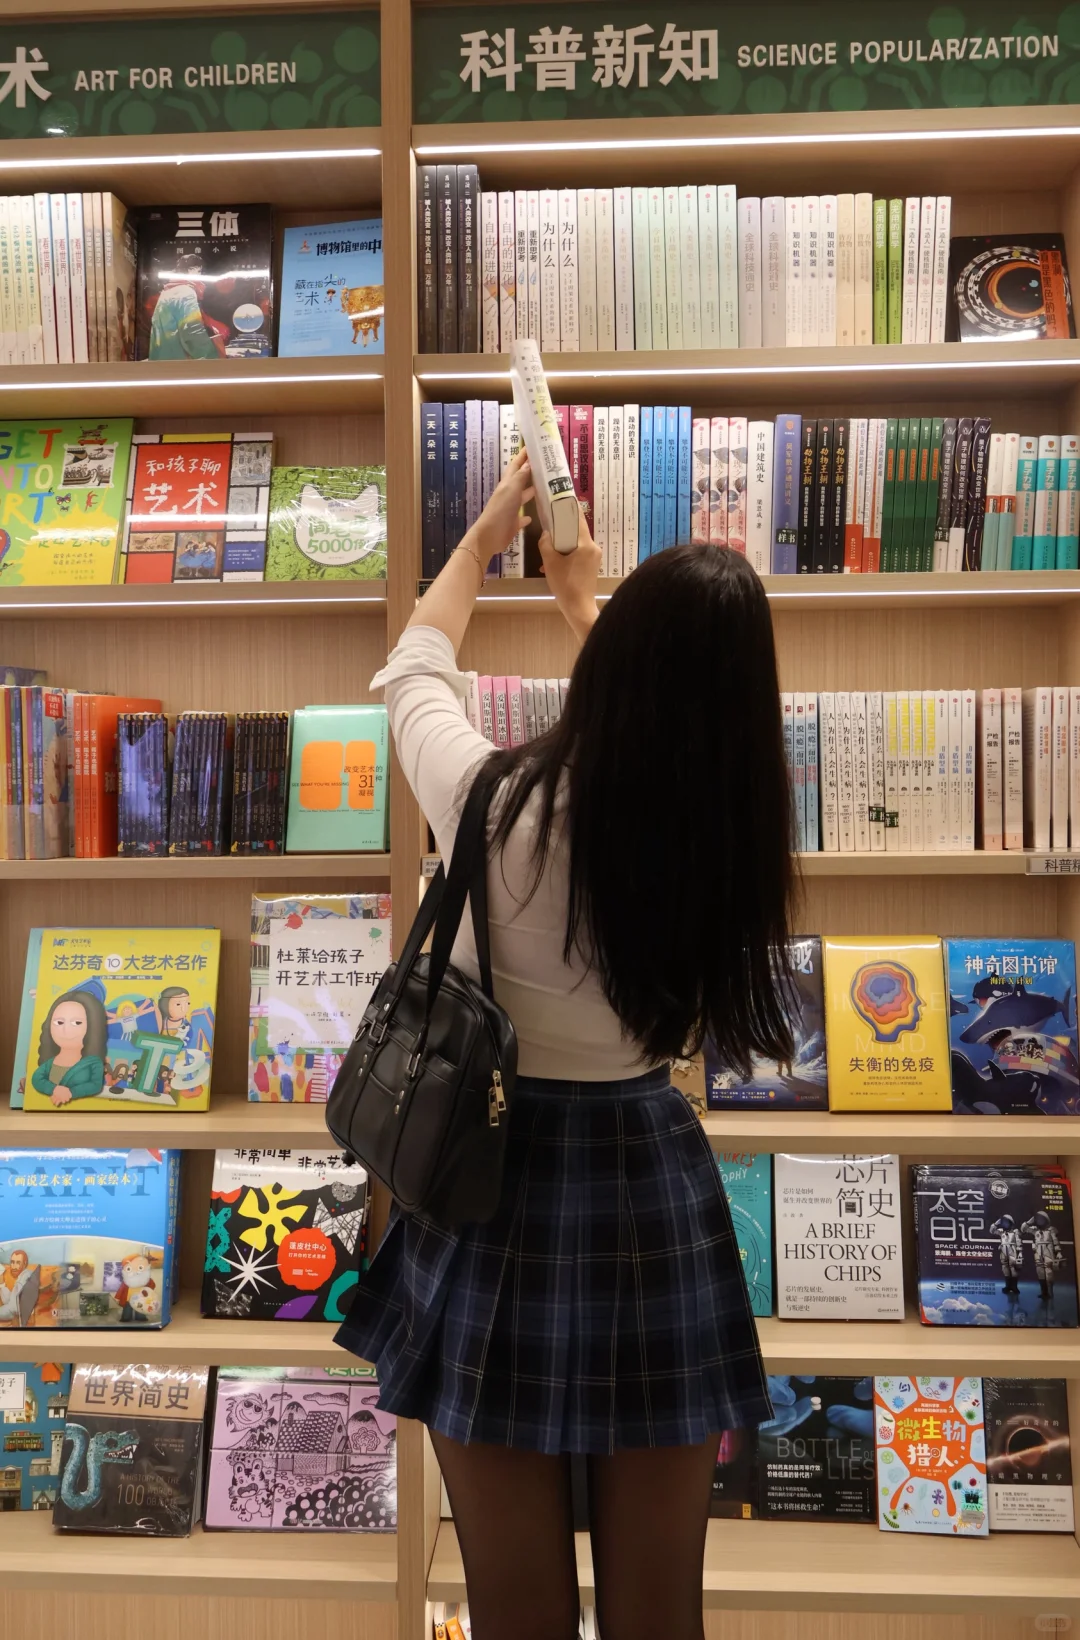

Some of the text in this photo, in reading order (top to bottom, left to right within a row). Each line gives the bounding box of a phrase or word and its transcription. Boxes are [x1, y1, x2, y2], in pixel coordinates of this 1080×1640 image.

[459, 23, 720, 92] 科普新知
[737, 35, 1060, 68] SCIENCE POPULARIZATION
[0, 46, 52, 108] 术
[74, 62, 297, 92] ART FOR CHILDREN
[175, 212, 240, 237] 三体
[42, 237, 51, 275] 看世界
[58, 237, 67, 276] 看世界
[74, 237, 84, 275] 看世界
[484, 222, 497, 286] 自由的进化
[501, 222, 514, 286] 自由的进化
[517, 229, 526, 263] 重新思考
[529, 229, 538, 263] 重新思考
[542, 222, 556, 268] 为什么
[561, 222, 575, 268] 为什么
[792, 231, 800, 267] 知识机器
[809, 231, 817, 267] 知识机器
[827, 231, 835, 267] 知识机器
[294, 273, 346, 290] 藏在指尖的
[426, 413, 436, 460] 一天一朵云
[449, 413, 459, 461] 一天一朵云
[145, 455, 222, 476] 和孩子聊
[756, 431, 766, 483] 中国建筑史
[0, 463, 54, 490] NTO
[2, 492, 53, 525] RT
[142, 482, 220, 517] 艺术
[777, 532, 796, 544] 样书
[343, 765, 383, 773] 改变艺术的
[358, 774, 383, 789] 31种
[358, 789, 375, 797] 凝视
[52, 953, 208, 972] 达芬奇10大艺术名作
[276, 947, 364, 964] 杜莱给孩子
[964, 955, 1058, 976] 神奇图书馆
[276, 970, 383, 986] 开艺术工作坊
[848, 1056, 935, 1073] 失衡的免疫
[721, 1168, 748, 1184] OPHY
[835, 1154, 894, 1184] 芯片
[783, 1187, 814, 1195] 芯片是如何
[783, 1197, 833, 1205] 诞生并改变世界的
[835, 1188, 895, 1218] 简史
[913, 1188, 985, 1214] 太空
[805, 1223, 876, 1239] A BRIEF
[931, 1217, 988, 1242] 日记
[289, 1241, 327, 1251] 蓬皮杜中心
[784, 1244, 897, 1260] HISTORY OF
[824, 1265, 882, 1282] CHIPS
[85, 1379, 190, 1410] 世界简史
[897, 1415, 966, 1442] 微生物
[777, 1437, 863, 1459] BOTTLE
[907, 1443, 955, 1468] 猎人
[827, 1458, 876, 1480] LIES
[117, 1484, 145, 1505] 100
